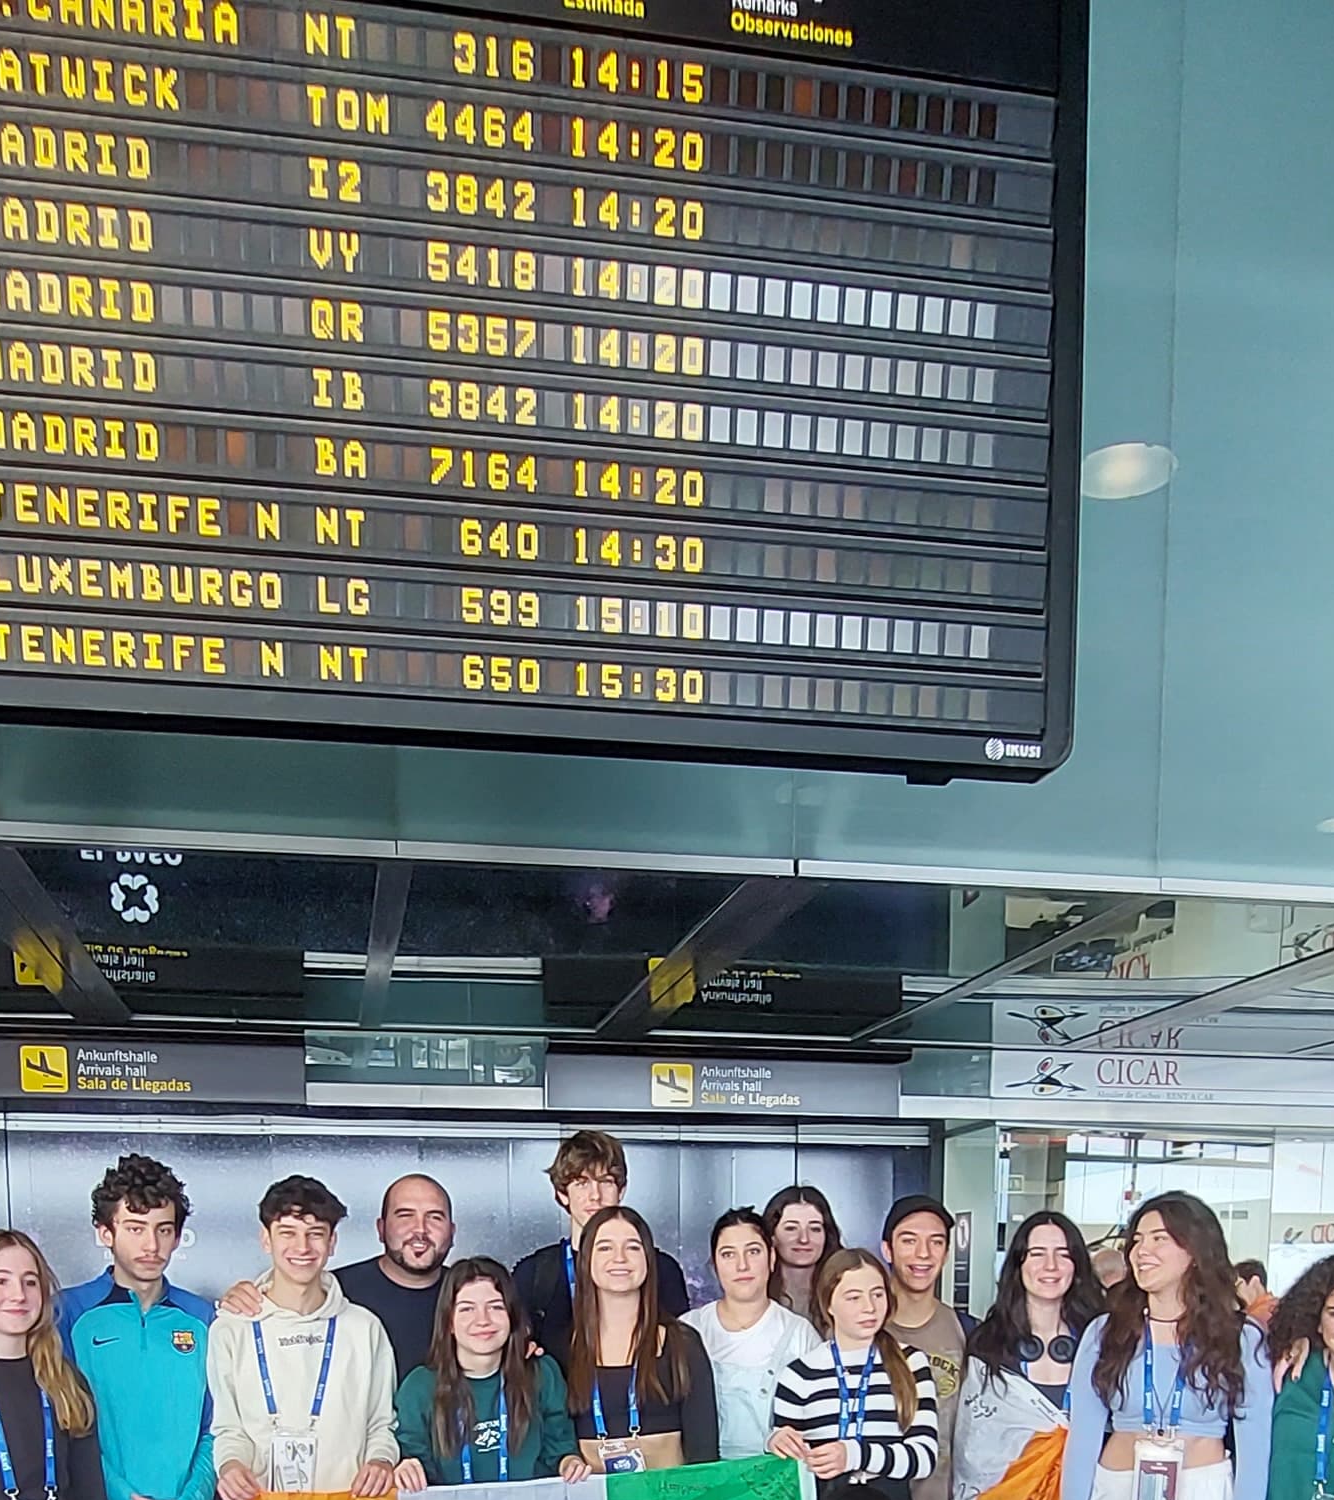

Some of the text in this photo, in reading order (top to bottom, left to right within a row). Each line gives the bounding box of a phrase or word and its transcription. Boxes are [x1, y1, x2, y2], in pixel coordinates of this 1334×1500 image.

[731, 13, 852, 47] Observaciones
[305, 16, 354, 57] NT
[454, 32, 532, 81] 316
[572, 48, 703, 103] 14:15
[308, 86, 387, 131] TOM
[427, 103, 531, 148] 4464
[572, 119, 703, 170] 14:20
[311, 158, 359, 200] I2
[428, 172, 533, 218] 3842
[573, 188, 702, 239] 14:20
[309, 229, 358, 271] VY
[428, 240, 534, 289] 5418
[571, 240, 704, 309] 14:20
[311, 299, 361, 340] QR
[427, 310, 534, 356] 5357
[572, 308, 704, 376] 14:20
[314, 369, 363, 409] IB
[427, 380, 534, 424] 3842
[574, 389, 704, 442] 14:20
[317, 438, 364, 475] BA
[431, 447, 534, 491] 7164
[575, 461, 702, 506] 14:20
[257, 506, 278, 537] N
[316, 511, 363, 546] NT
[460, 519, 537, 559] 640
[575, 529, 702, 572] 14:30
[318, 580, 367, 616] LG
[462, 588, 537, 626] 599
[574, 592, 704, 642] 15:10
[261, 645, 282, 672] N
[321, 648, 365, 679] NT
[463, 656, 538, 692] 650
[575, 664, 701, 702] 15:30
[1005, 743, 1042, 761] IKUSI
[76, 1048, 158, 1063] Ankunftshalle
[77, 1063, 147, 1077] Arrivals hall
[701, 1066, 772, 1079] Ankunftshalle
[1097, 1058, 1181, 1086] CICAR
[77, 1077, 192, 1094] Sala de Llegadas
[701, 1080, 762, 1092] Arrivals hall
[701, 1092, 800, 1108] Sala de Llegadas
